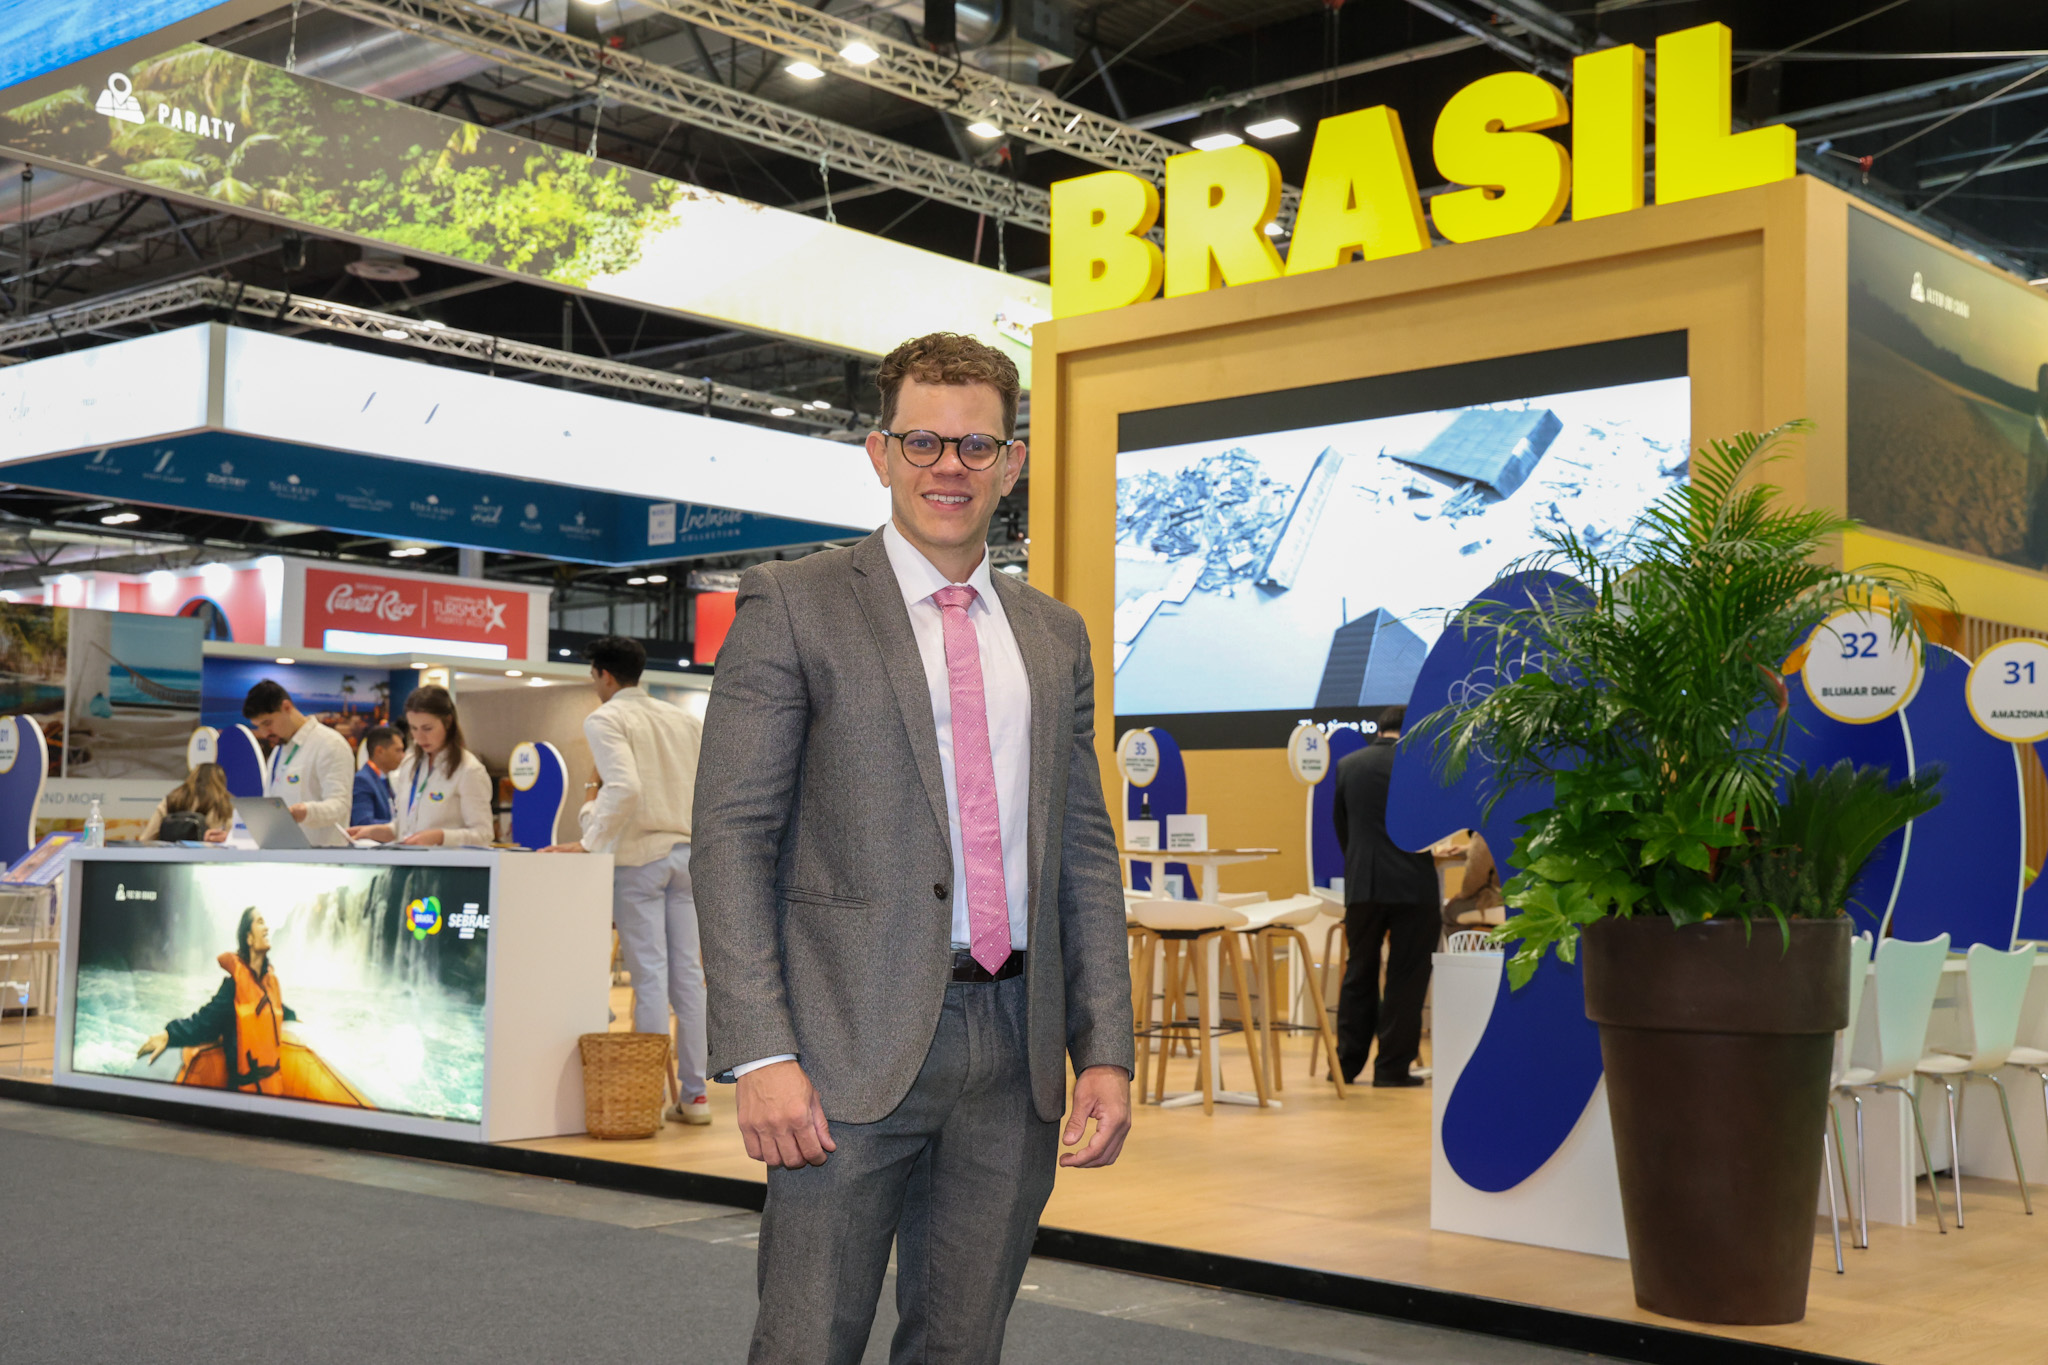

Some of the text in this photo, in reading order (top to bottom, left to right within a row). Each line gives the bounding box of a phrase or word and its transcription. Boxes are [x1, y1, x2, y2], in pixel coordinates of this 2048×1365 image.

[158, 102, 235, 143] PARATY
[1050, 22, 1796, 319] BRASIL
[326, 583, 417, 621] Puerto Rico
[1840, 632, 1878, 658] 32
[2003, 661, 2034, 684] 31
[1822, 686, 1896, 697] BLUMAR DMC
[1135, 742, 1146, 755] 35
[1306, 737, 1318, 751] 34
[447, 913, 490, 929] SEBRAE
